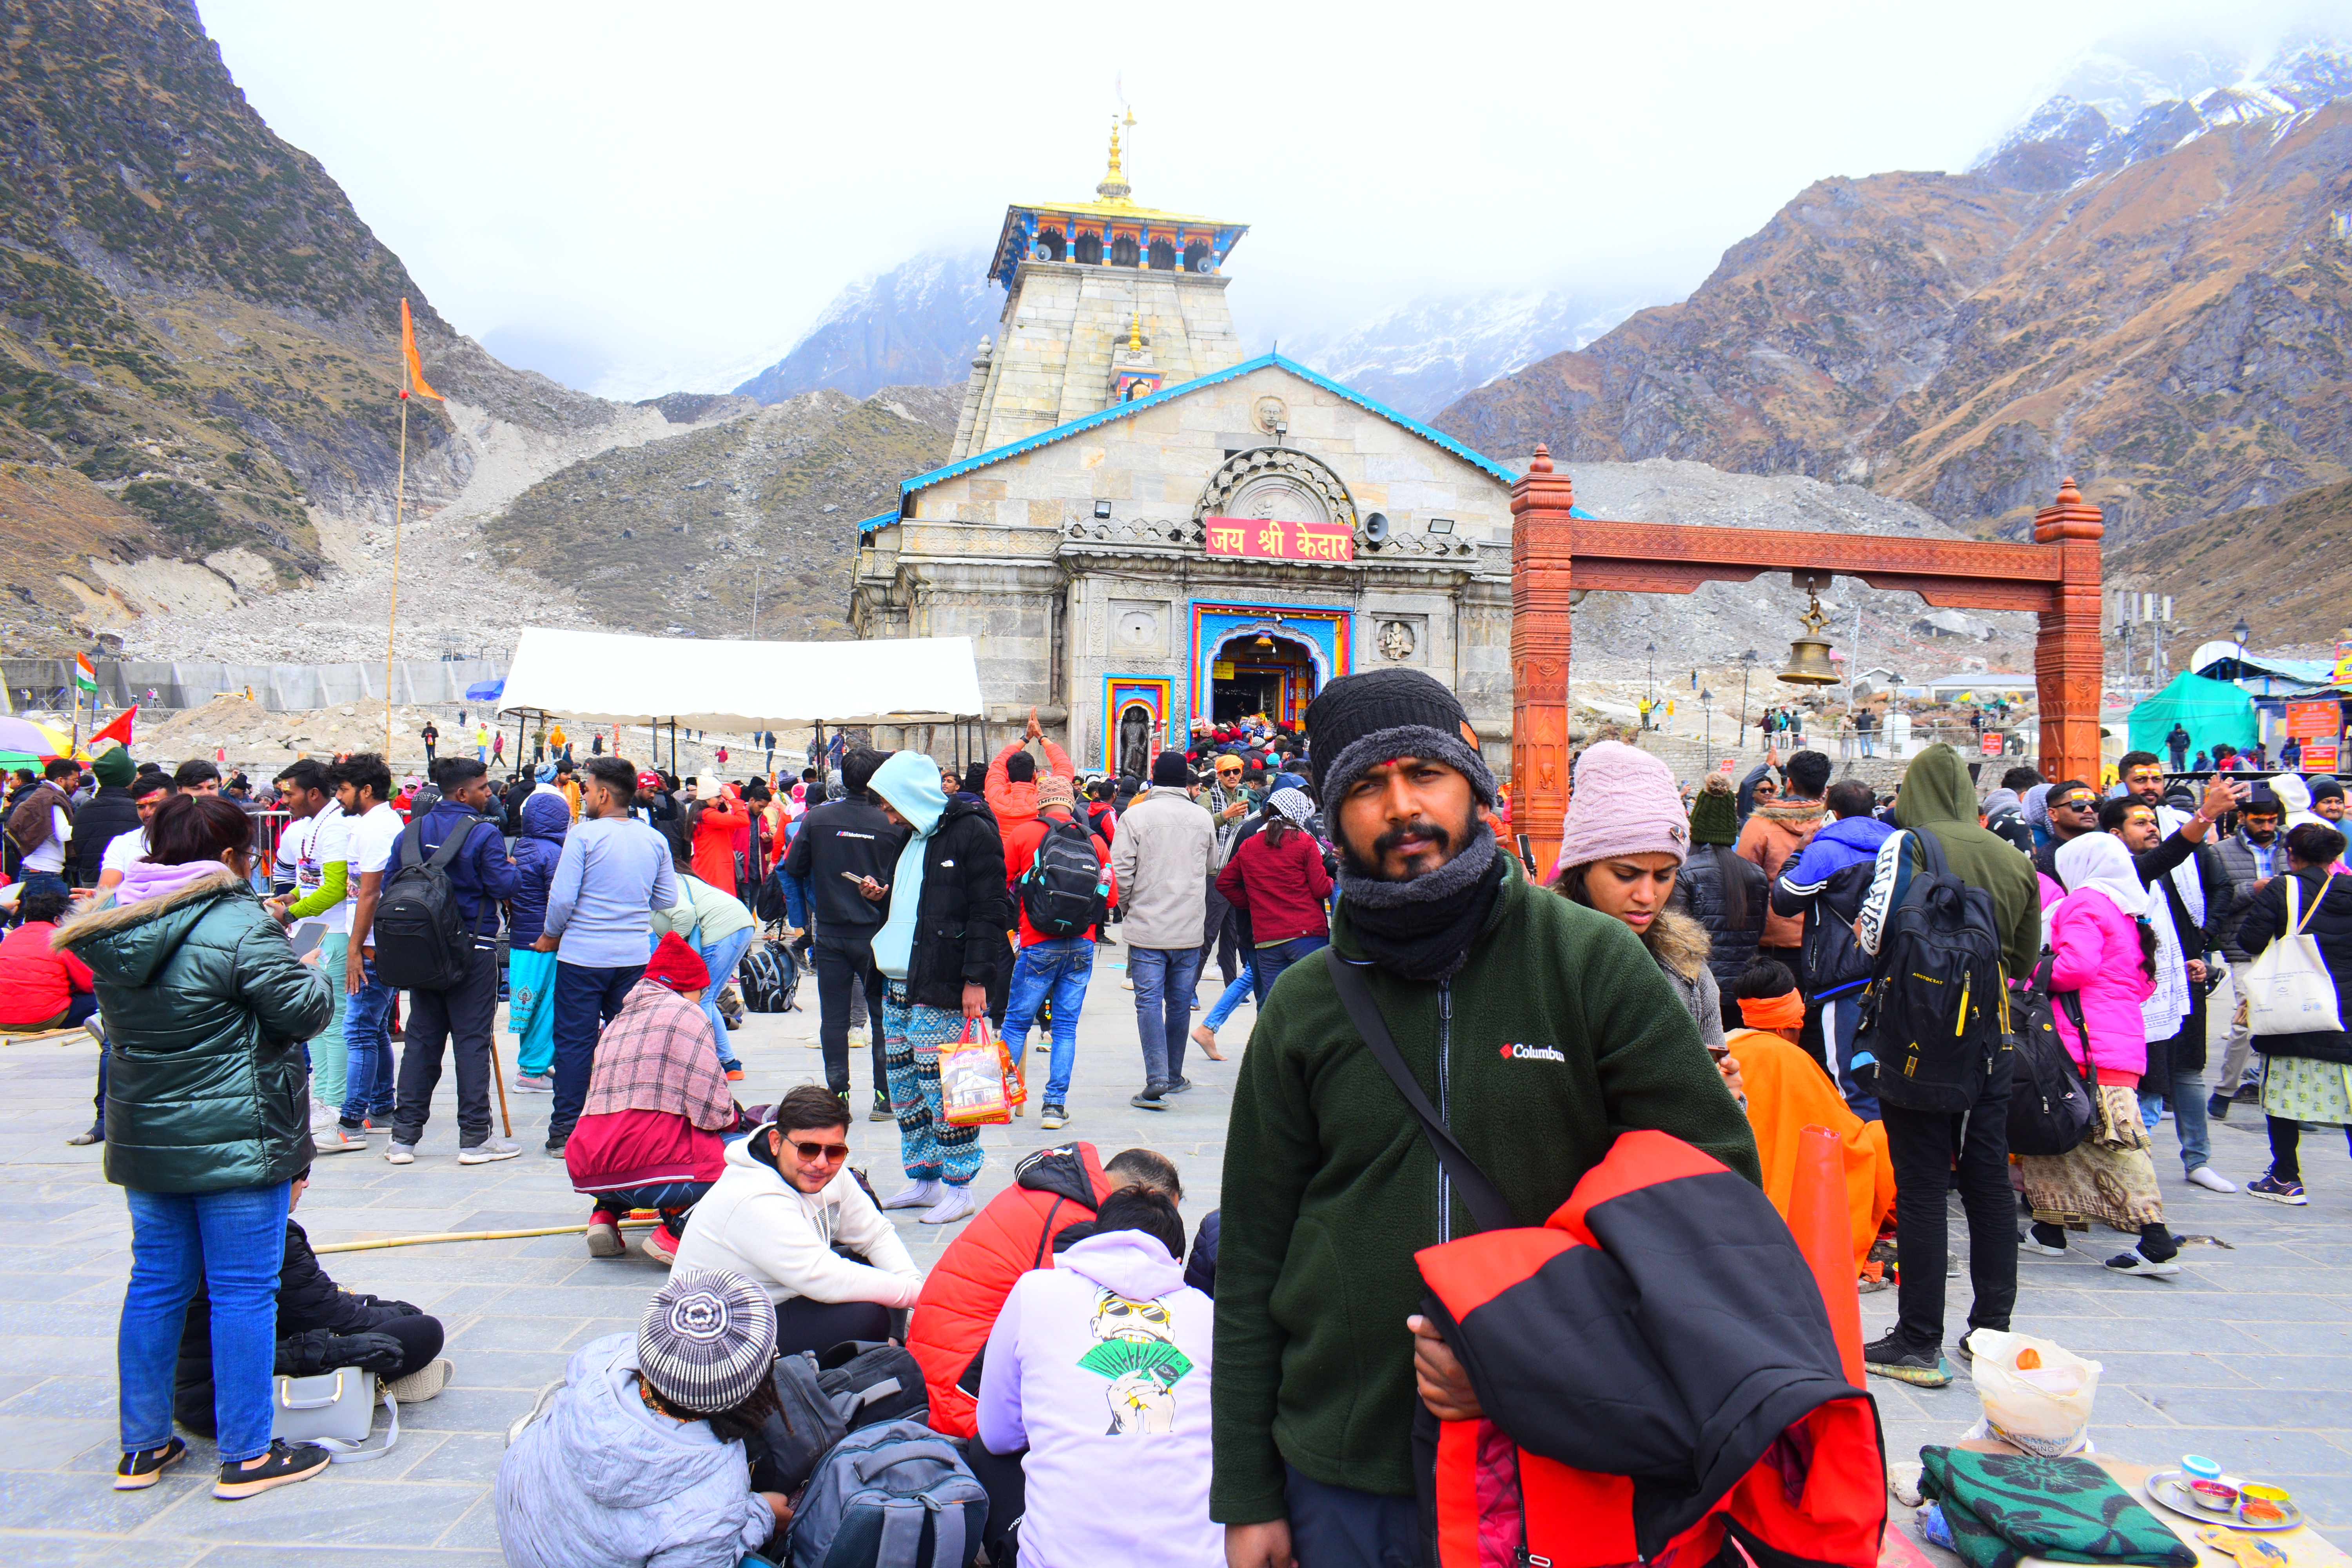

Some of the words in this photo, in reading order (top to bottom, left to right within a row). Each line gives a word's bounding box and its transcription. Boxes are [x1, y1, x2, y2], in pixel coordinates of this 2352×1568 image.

[1211, 528, 1245, 555] जय
[1257, 521, 1284, 557] श्री
[1296, 522, 1348, 561] केदार
[1912, 973, 1943, 985] ARISTOCRAT
[1513, 1043, 1565, 1062] Columbus
[2026, 1444, 2054, 1452] GING
